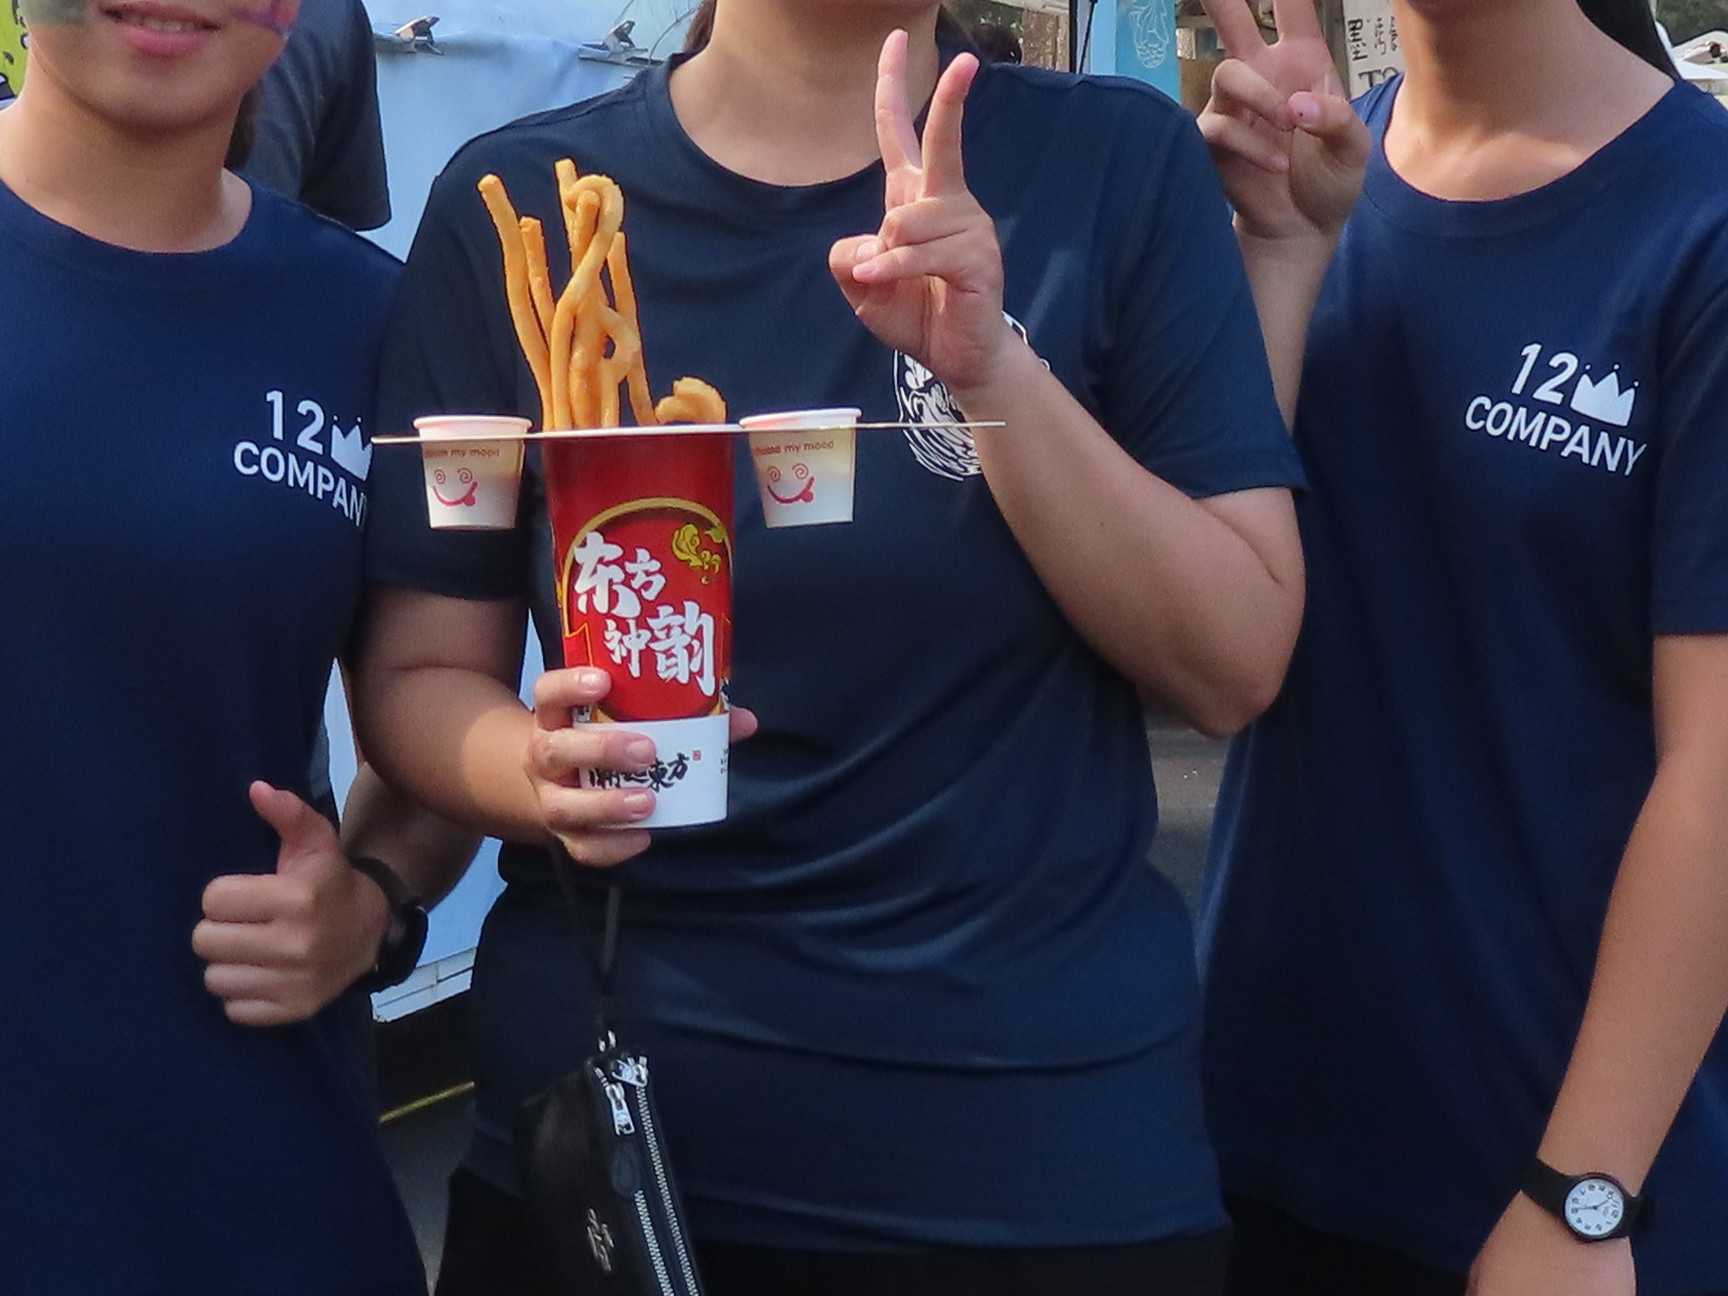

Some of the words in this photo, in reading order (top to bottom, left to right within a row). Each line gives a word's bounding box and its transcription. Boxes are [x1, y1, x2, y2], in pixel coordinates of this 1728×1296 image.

[1511, 342, 1579, 405] 12
[266, 389, 325, 455] 12
[1465, 396, 1647, 476] COMPANY
[573, 531, 666, 618] 东方
[603, 600, 716, 697] 神韵
